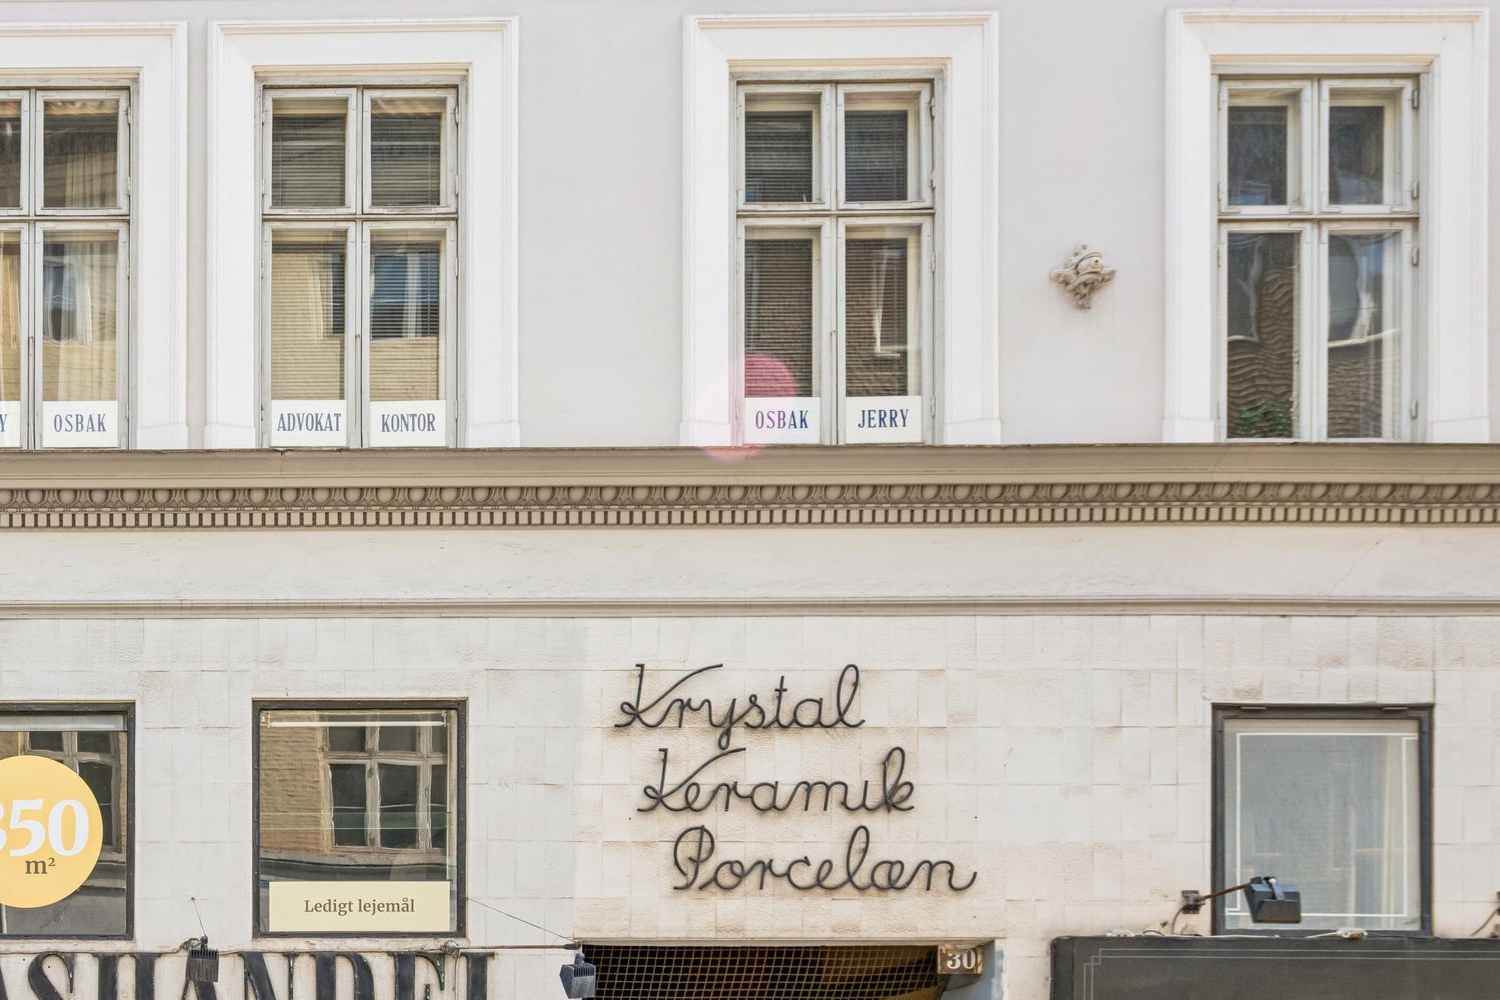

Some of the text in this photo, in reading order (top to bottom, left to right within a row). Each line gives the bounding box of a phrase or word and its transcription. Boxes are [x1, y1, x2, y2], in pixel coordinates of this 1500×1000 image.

[53, 414, 107, 433] OSBAK
[277, 412, 436, 433] ADVOKAT KONTOR
[755, 408, 909, 430] OSBAK JERRY
[614, 663, 866, 750] Krystal
[637, 746, 915, 813] Keramik
[673, 824, 977, 891] Porcelæn
[304, 897, 415, 916] Ledigt lejemål
[947, 949, 976, 969] 30
